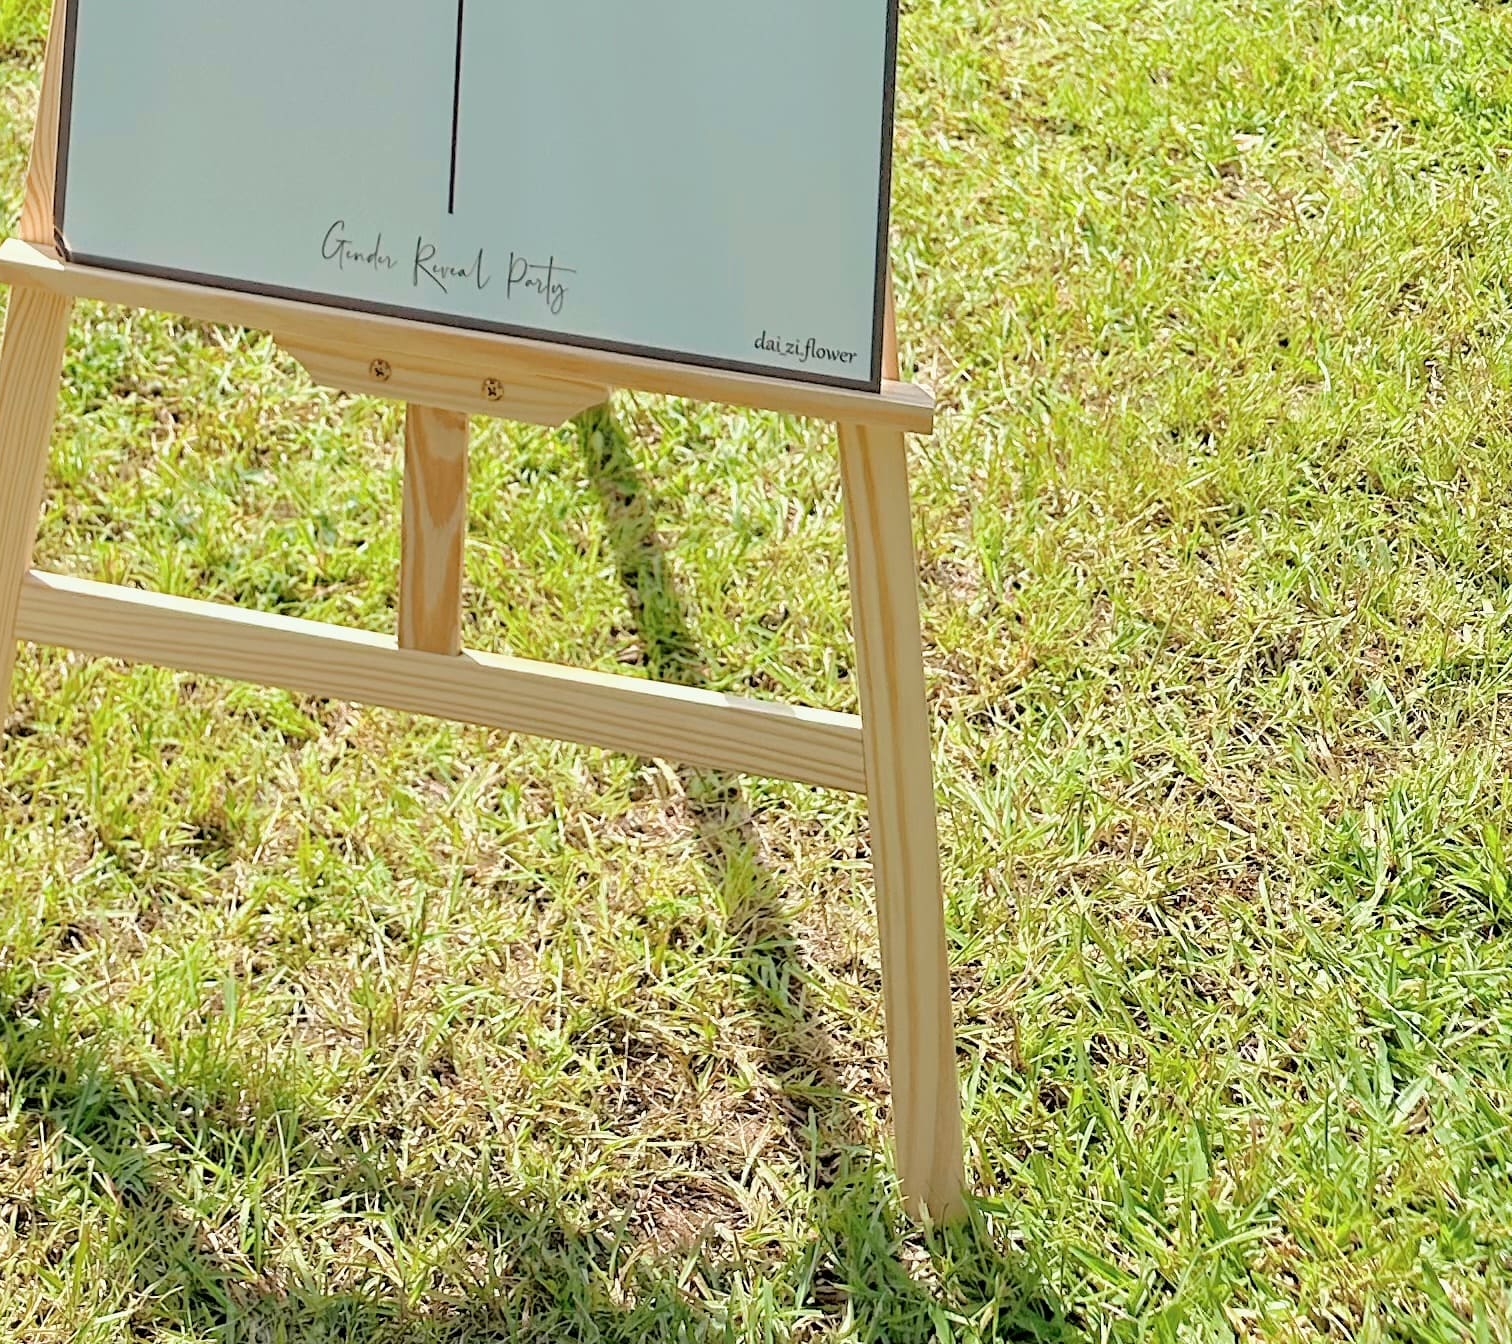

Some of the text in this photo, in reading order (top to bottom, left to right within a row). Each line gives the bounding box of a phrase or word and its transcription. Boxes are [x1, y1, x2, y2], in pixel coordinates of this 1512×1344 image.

[322, 220, 576, 315] Gender Reveal Party
